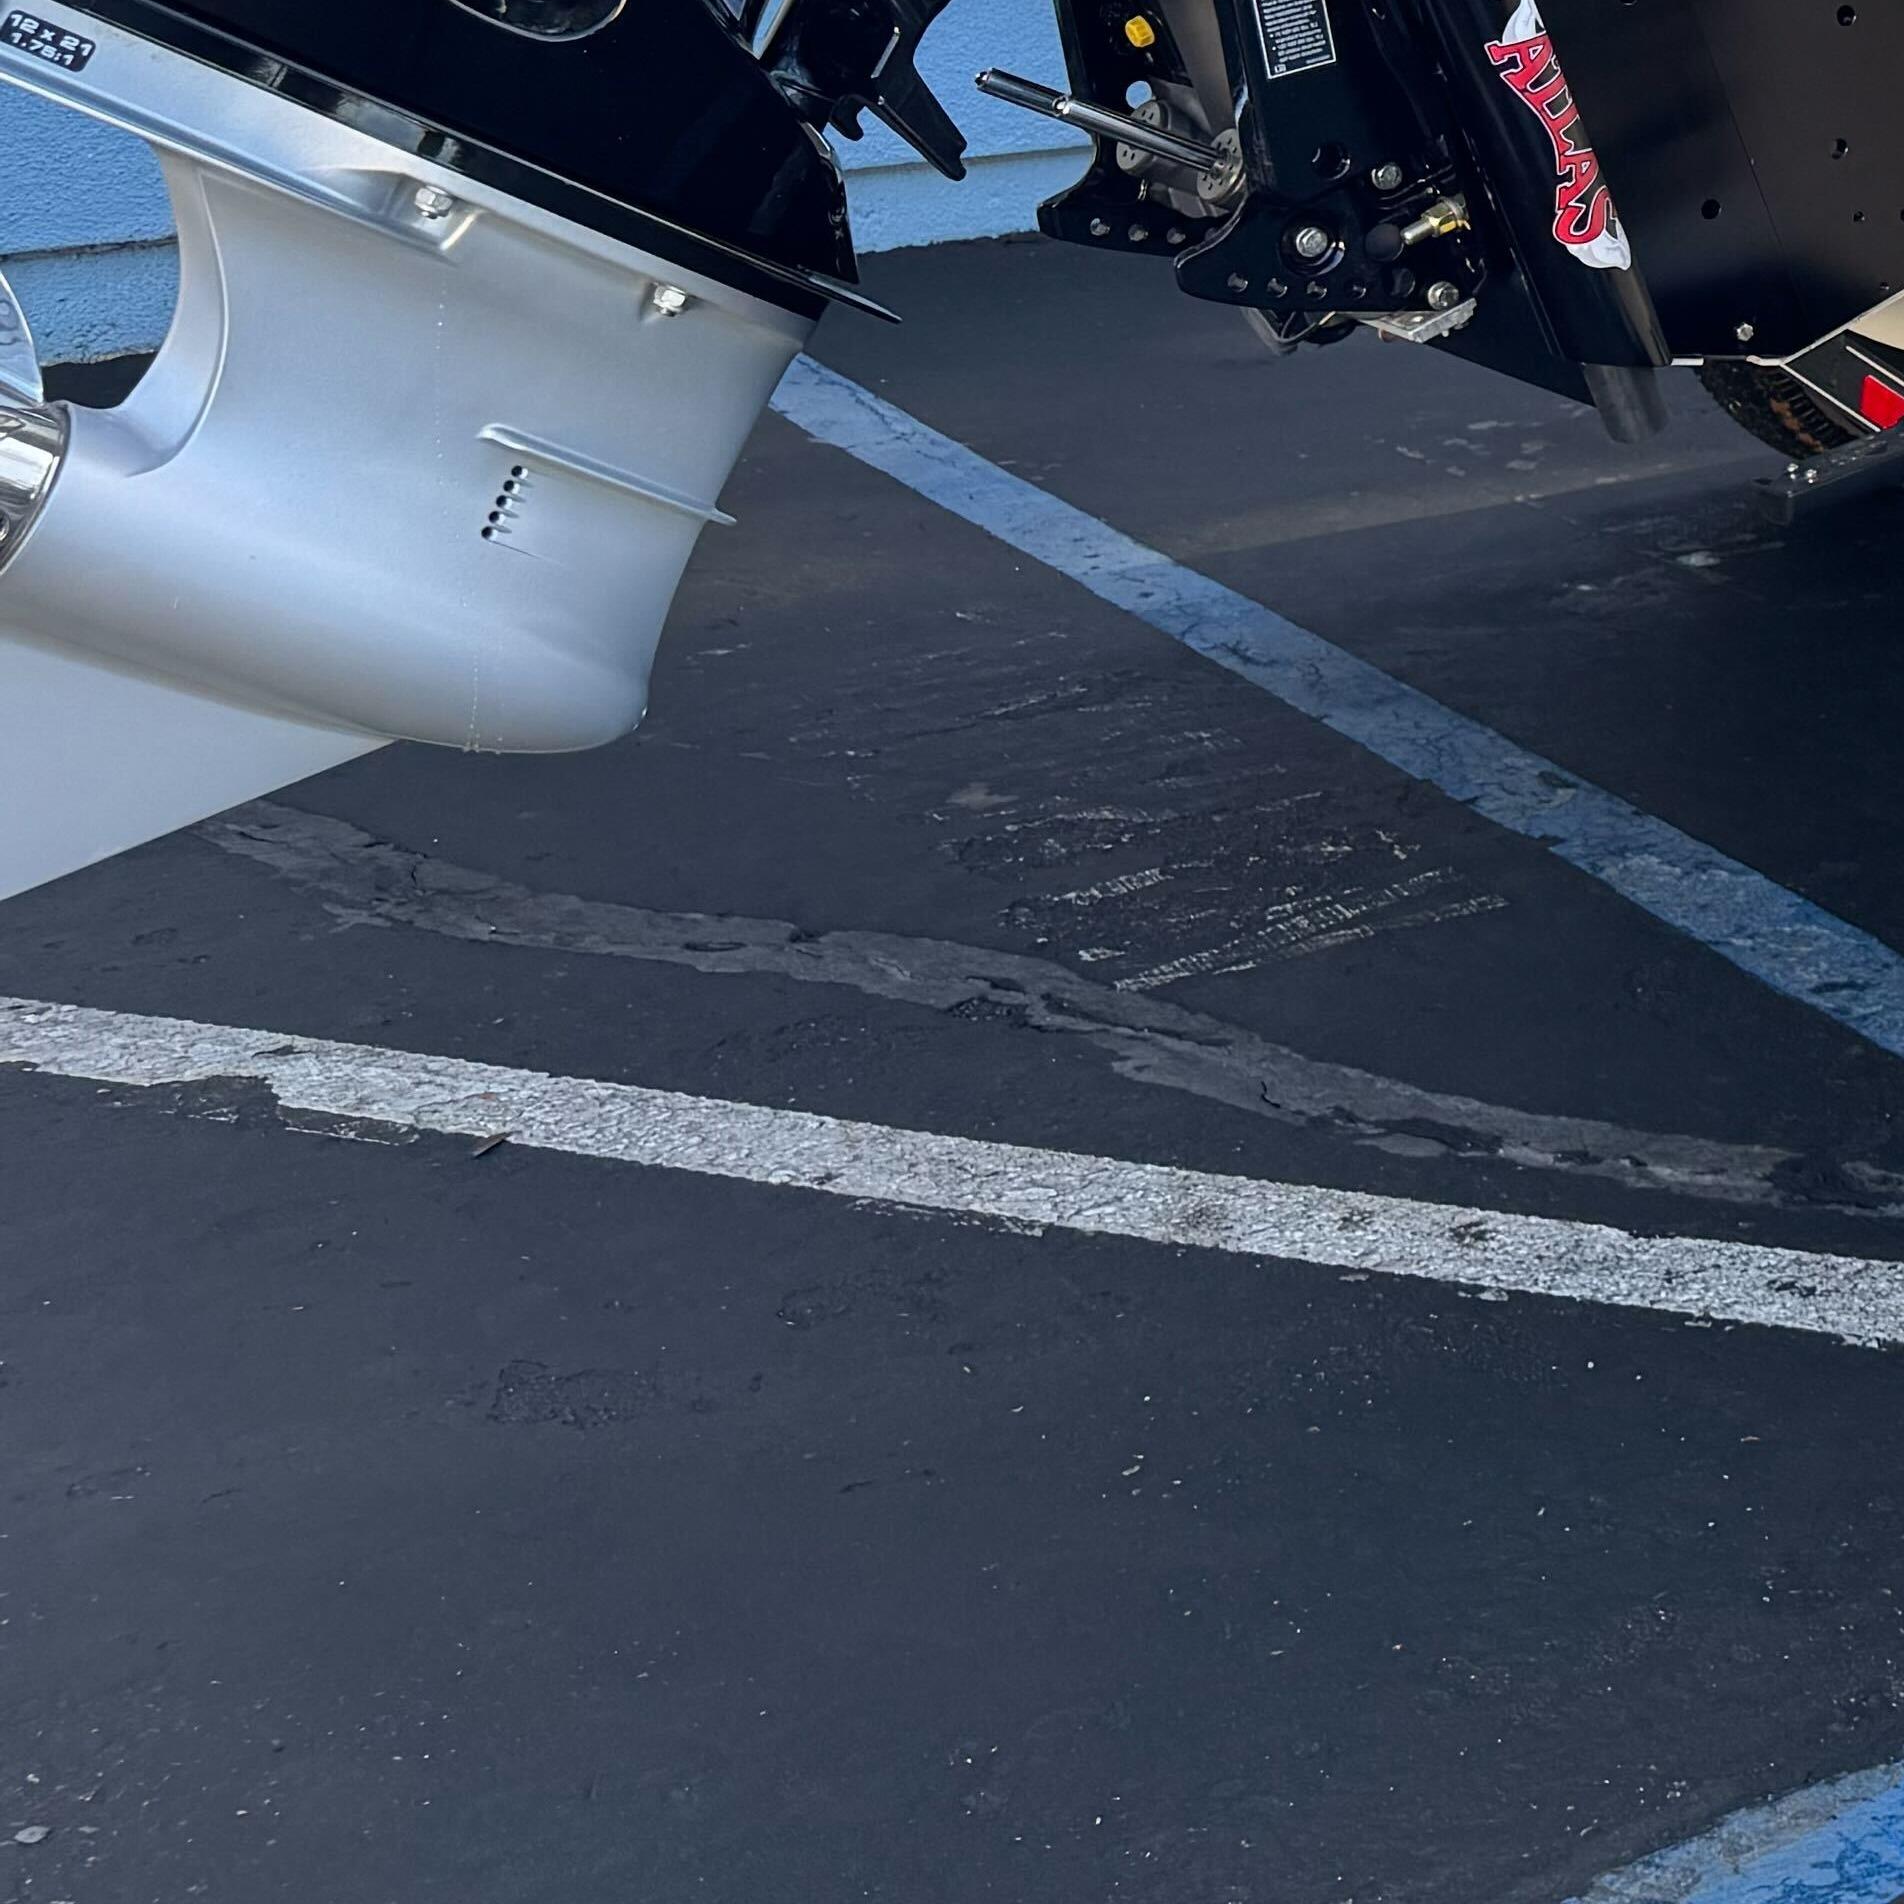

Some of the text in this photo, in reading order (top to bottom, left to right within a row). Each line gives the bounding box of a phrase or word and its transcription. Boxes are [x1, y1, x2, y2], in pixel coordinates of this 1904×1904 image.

[11, 14, 39, 34] 12
[60, 35, 92, 56] 21
[1484, 32, 1618, 246] ATLAS
